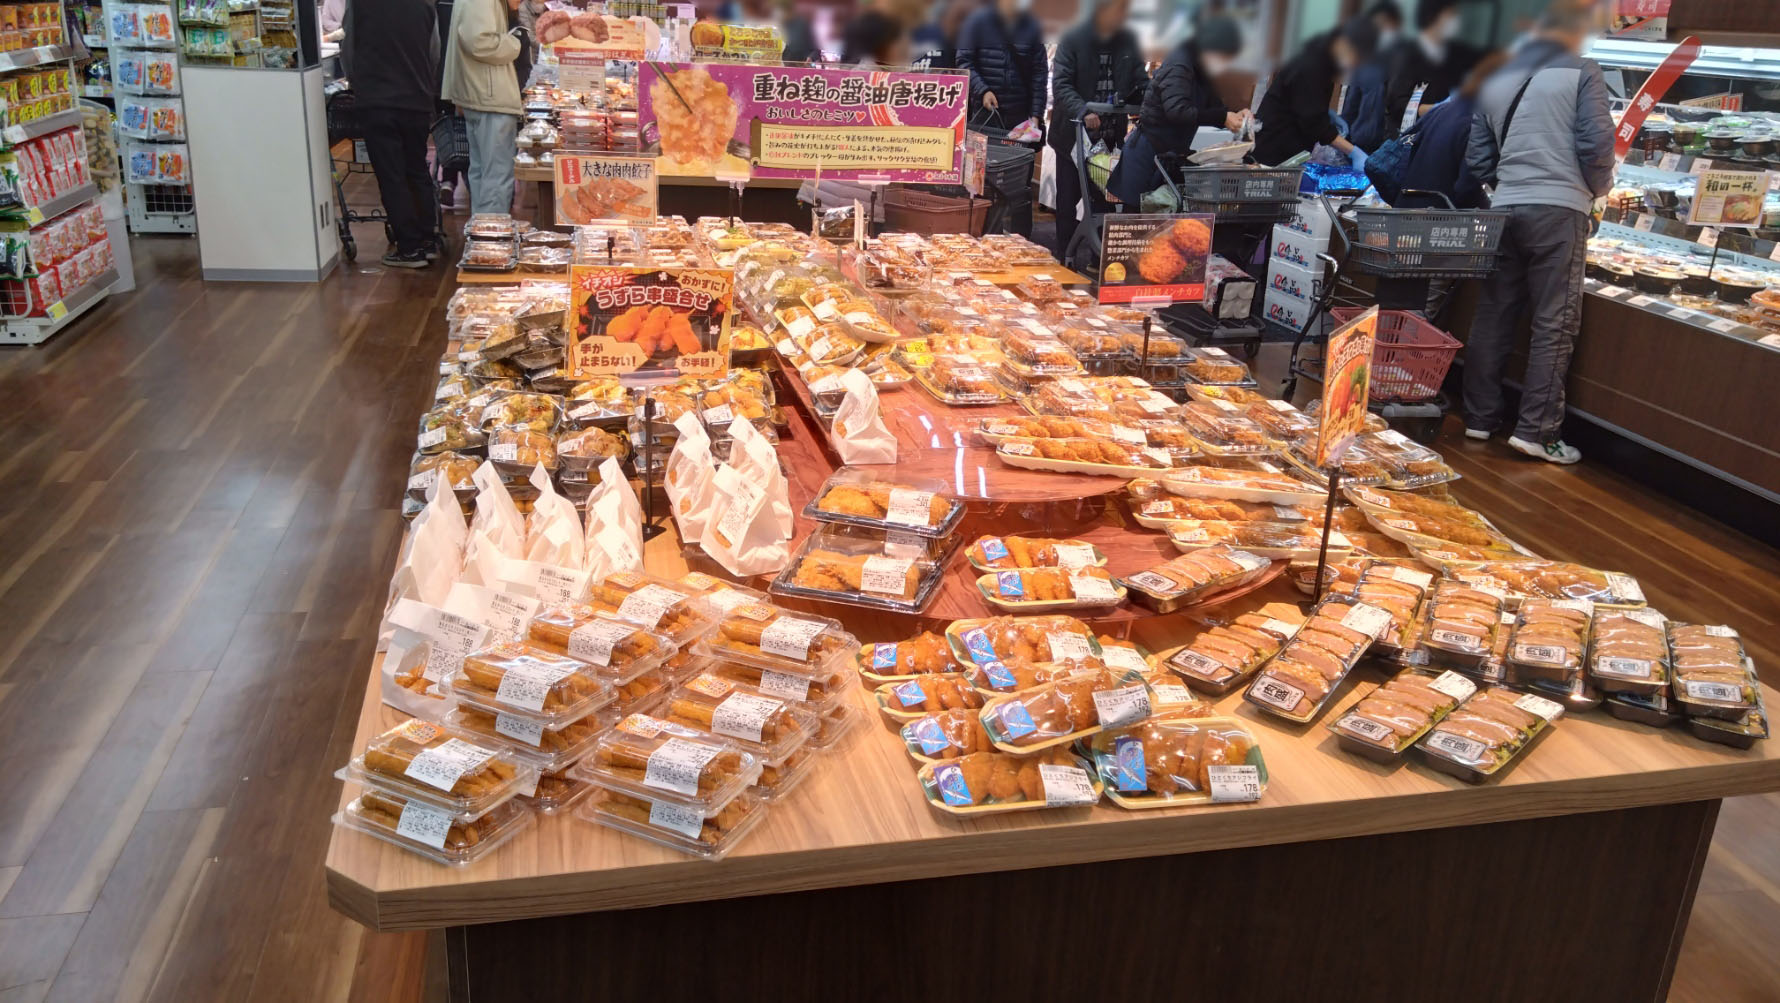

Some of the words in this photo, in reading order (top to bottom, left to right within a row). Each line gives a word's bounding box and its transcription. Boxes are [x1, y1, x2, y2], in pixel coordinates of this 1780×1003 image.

[766, 107, 856, 122] おいしさのヒミツ
[582, 161, 652, 179] 大きな肉肉餃子
[1430, 227, 1468, 238] 店内専用
[1429, 240, 1466, 248] TRIAL
[582, 274, 623, 289] イチオシ
[681, 275, 726, 292] おかずに!
[596, 286, 712, 311] うずら串盛合せ
[580, 343, 603, 354] 手が
[580, 356, 637, 367] 止まらない!
[1132, 697, 1148, 707] 178
[1076, 783, 1091, 791] 178
[1243, 783, 1258, 793] 178
